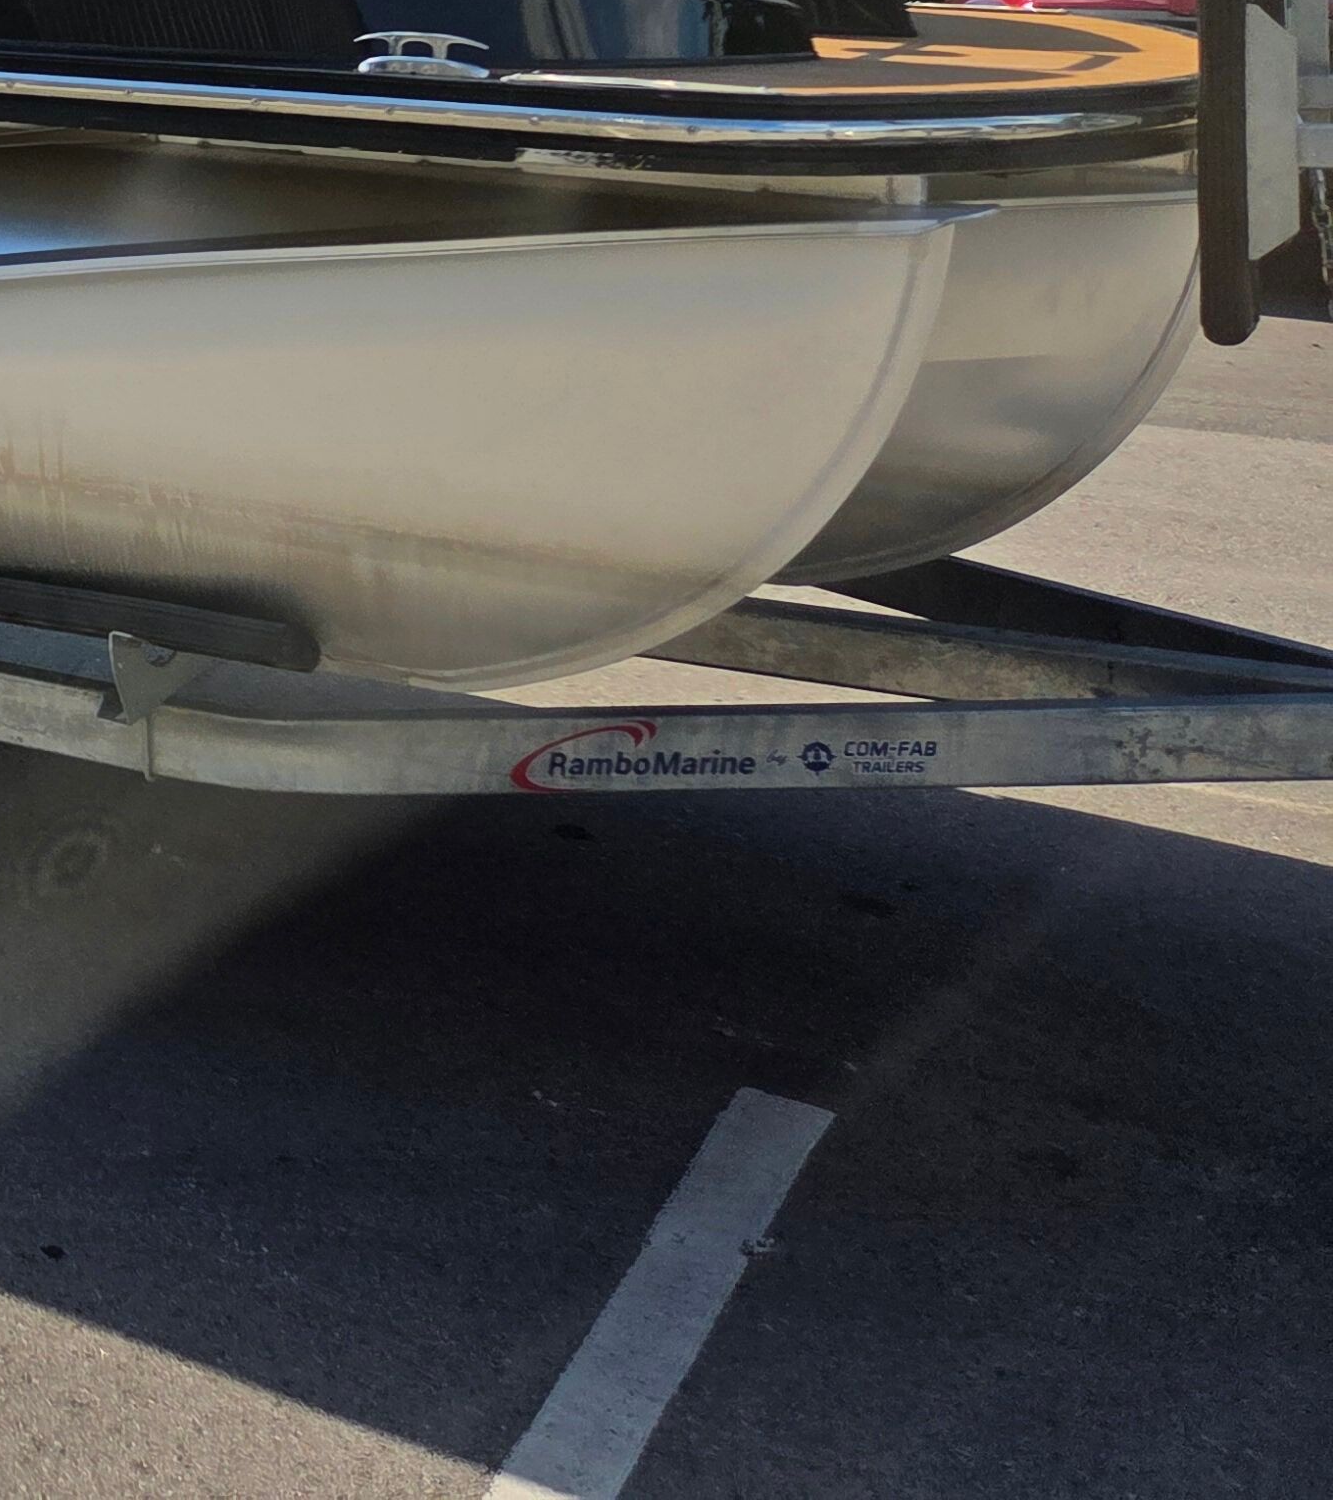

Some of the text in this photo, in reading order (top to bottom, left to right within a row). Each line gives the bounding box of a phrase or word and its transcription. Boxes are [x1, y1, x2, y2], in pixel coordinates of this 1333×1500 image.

[547, 749, 755, 777] RamboMarine
[843, 740, 938, 758] COM-FAB
[851, 760, 925, 774] TRAILERS
